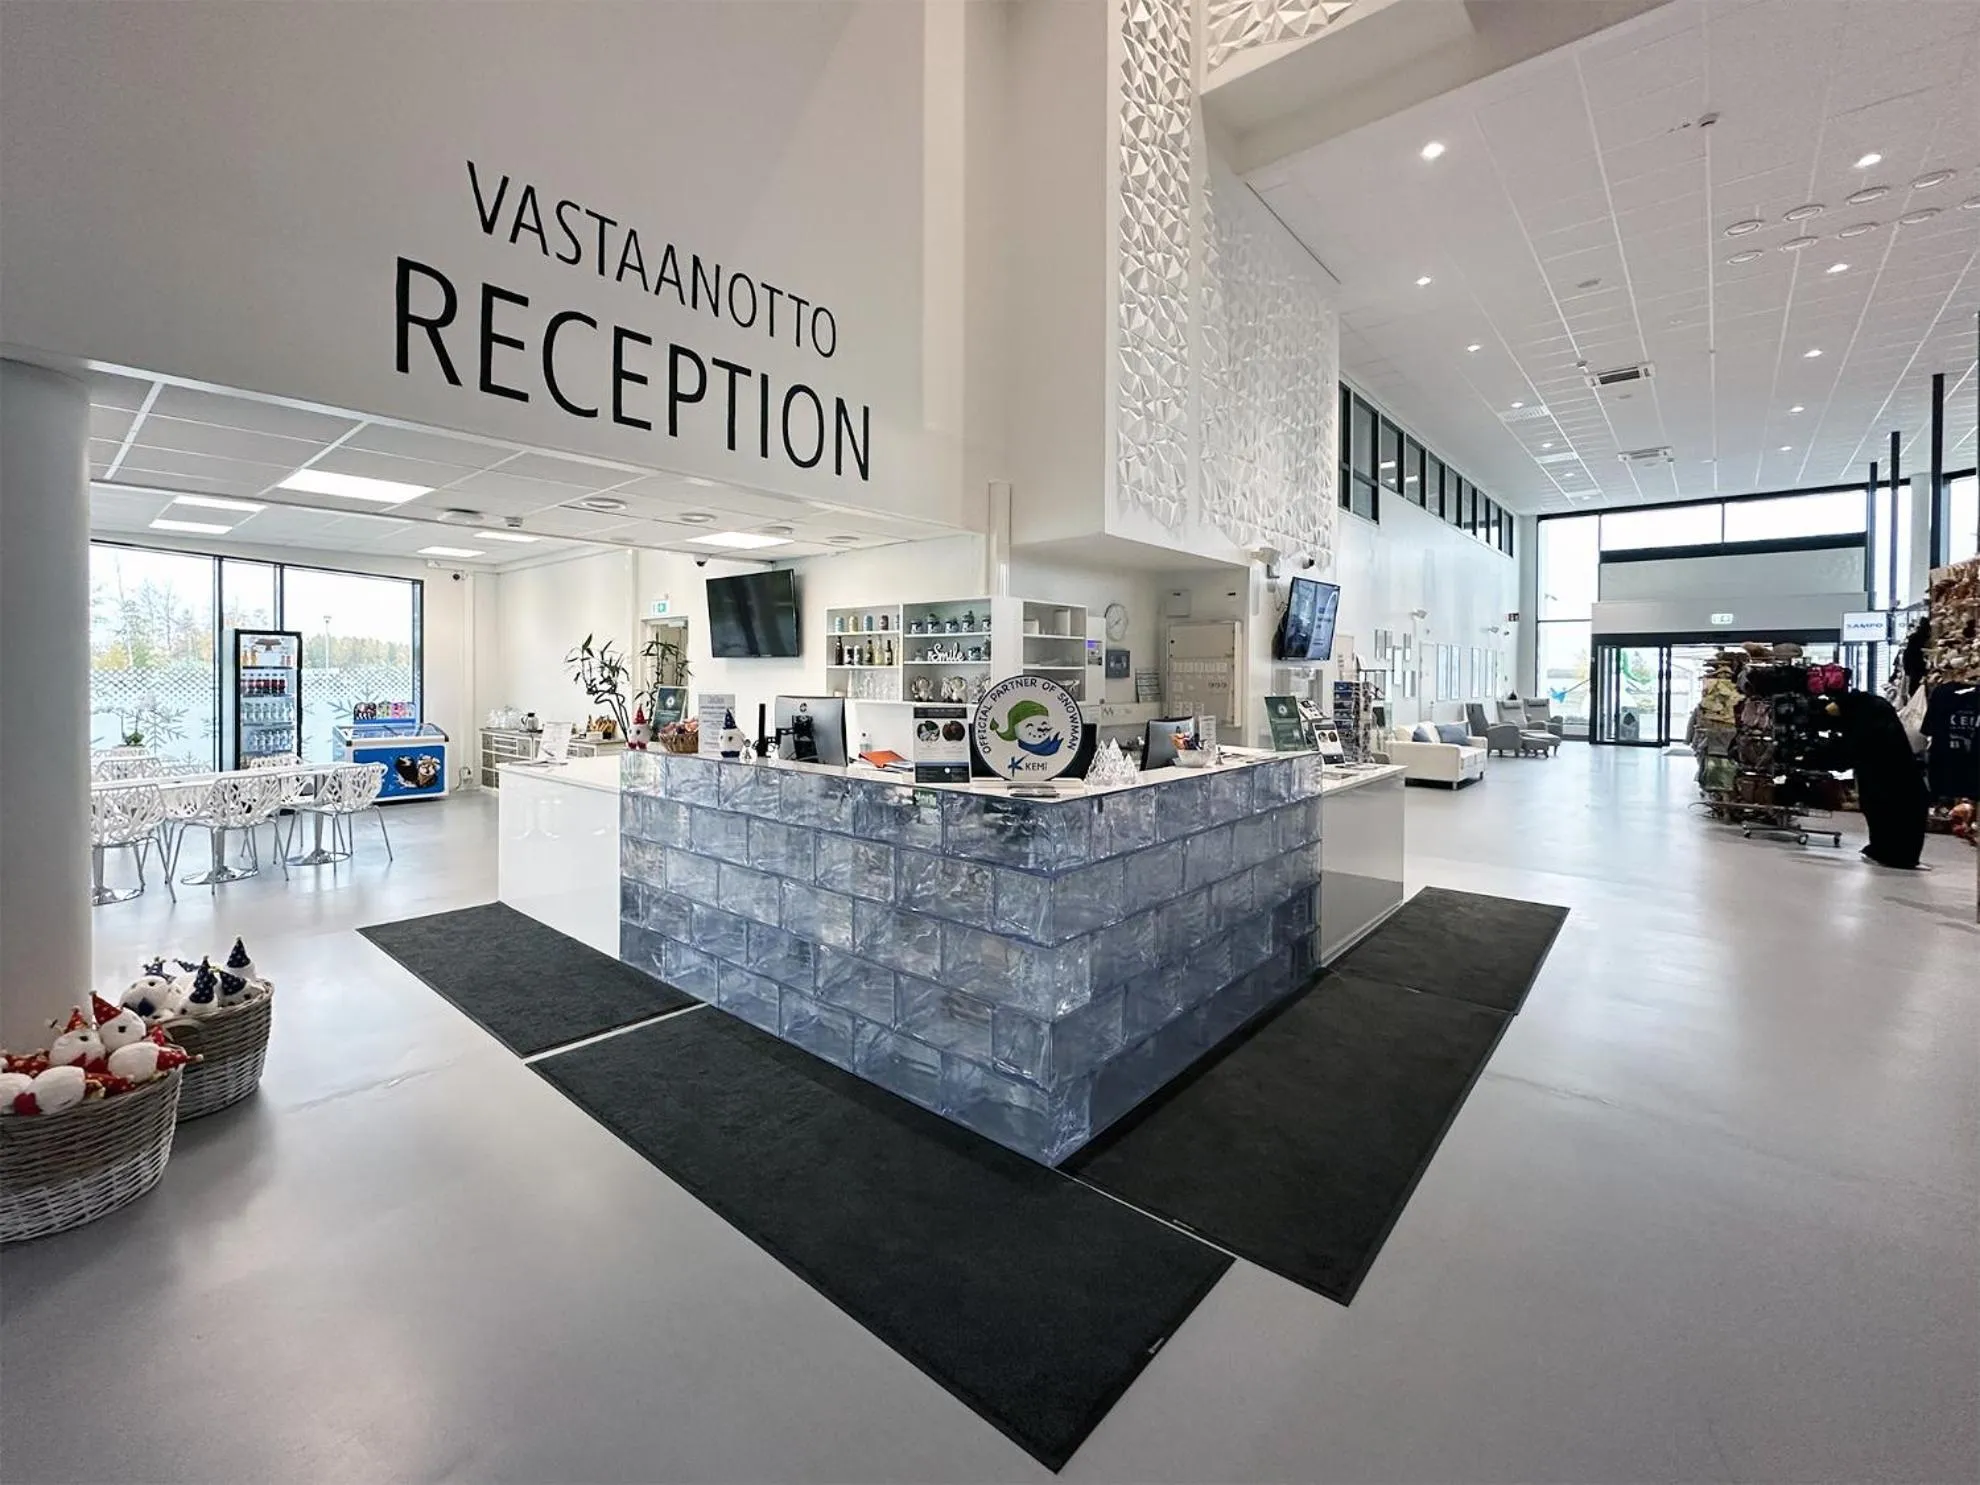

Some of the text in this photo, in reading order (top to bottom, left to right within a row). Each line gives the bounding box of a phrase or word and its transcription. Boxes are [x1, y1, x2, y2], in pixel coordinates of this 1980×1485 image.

[466, 160, 837, 358] VASTAANOTTO
[396, 256, 870, 481] RECEPTION
[931, 642, 965, 663] Smile
[978, 678, 1080, 754] OFFICIAL PARTNER OF SNOWMAN
[1025, 762, 1048, 771] KEMI
